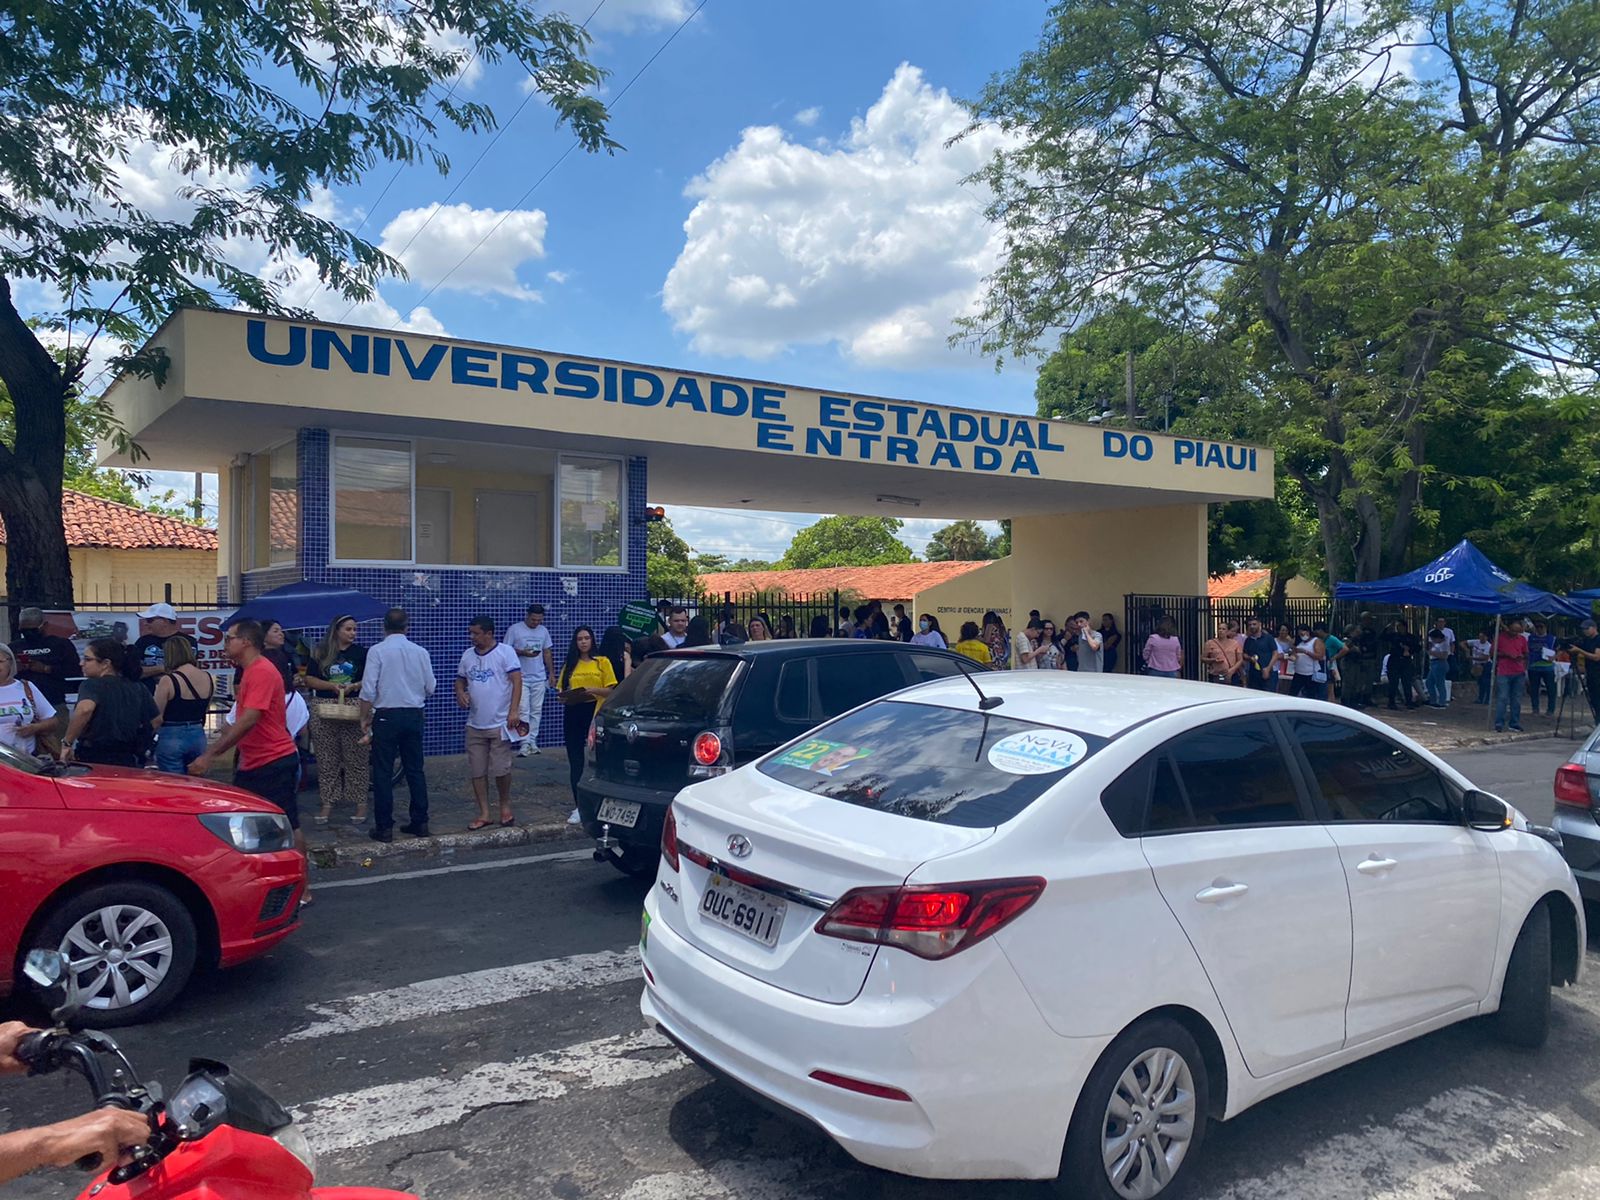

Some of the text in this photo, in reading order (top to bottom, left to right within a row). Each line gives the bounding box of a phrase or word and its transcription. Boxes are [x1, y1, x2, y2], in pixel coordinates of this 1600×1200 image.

[247, 319, 786, 421] UNIVERSIDADE
[819, 396, 1064, 452] ESTADUAL
[1103, 430, 1153, 461] DO
[757, 422, 1040, 475] ENTRADA
[789, 743, 830, 759] 22
[1020, 734, 1074, 752] NOVA
